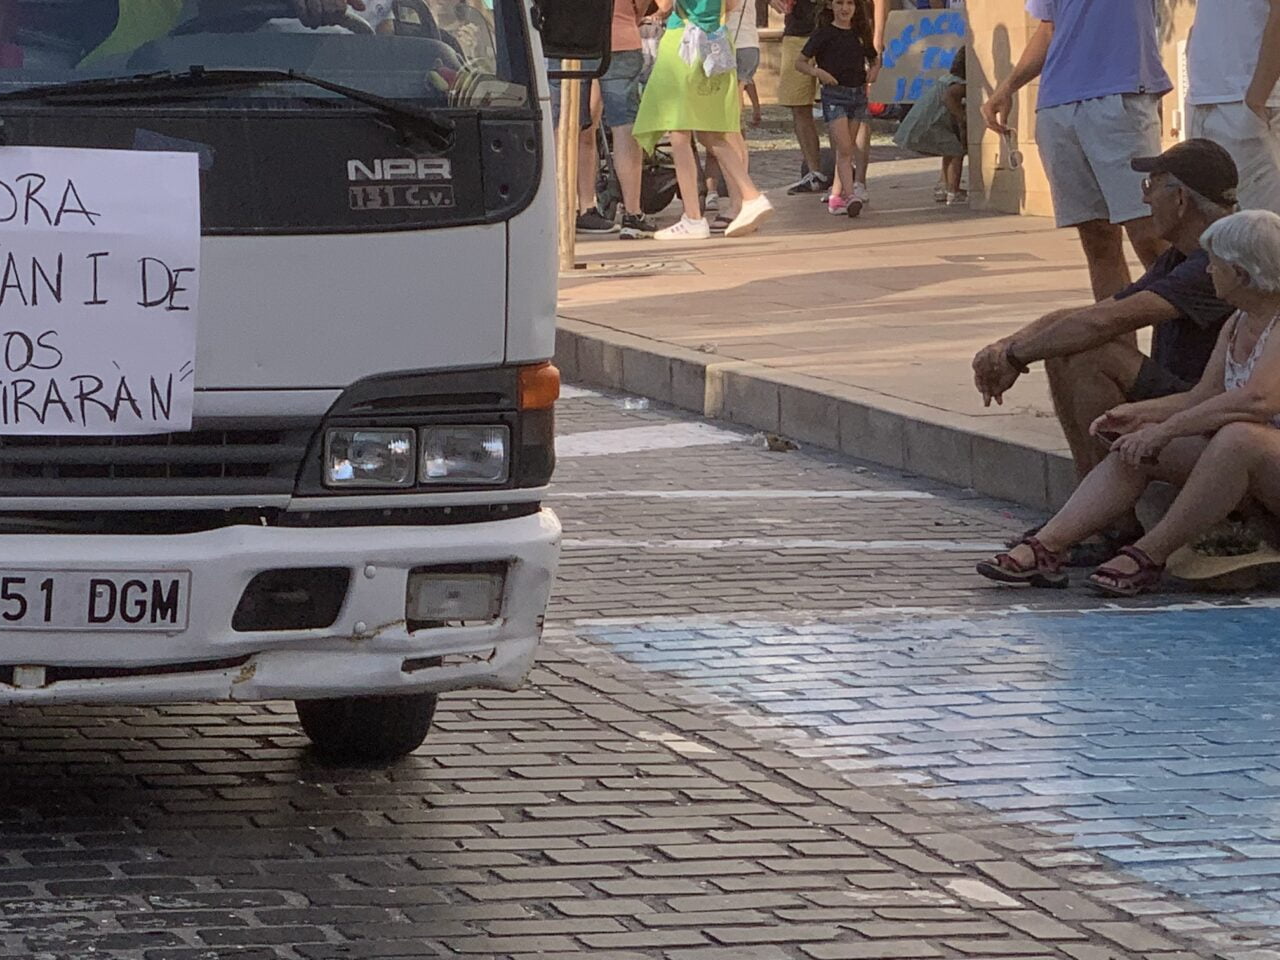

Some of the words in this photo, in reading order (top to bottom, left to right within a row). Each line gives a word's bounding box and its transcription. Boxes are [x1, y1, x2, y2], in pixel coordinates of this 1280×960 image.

[347, 158, 453, 181] NPR
[84, 252, 110, 304] I
[137, 257, 195, 311] DE
[87, 578, 180, 625] DGM
